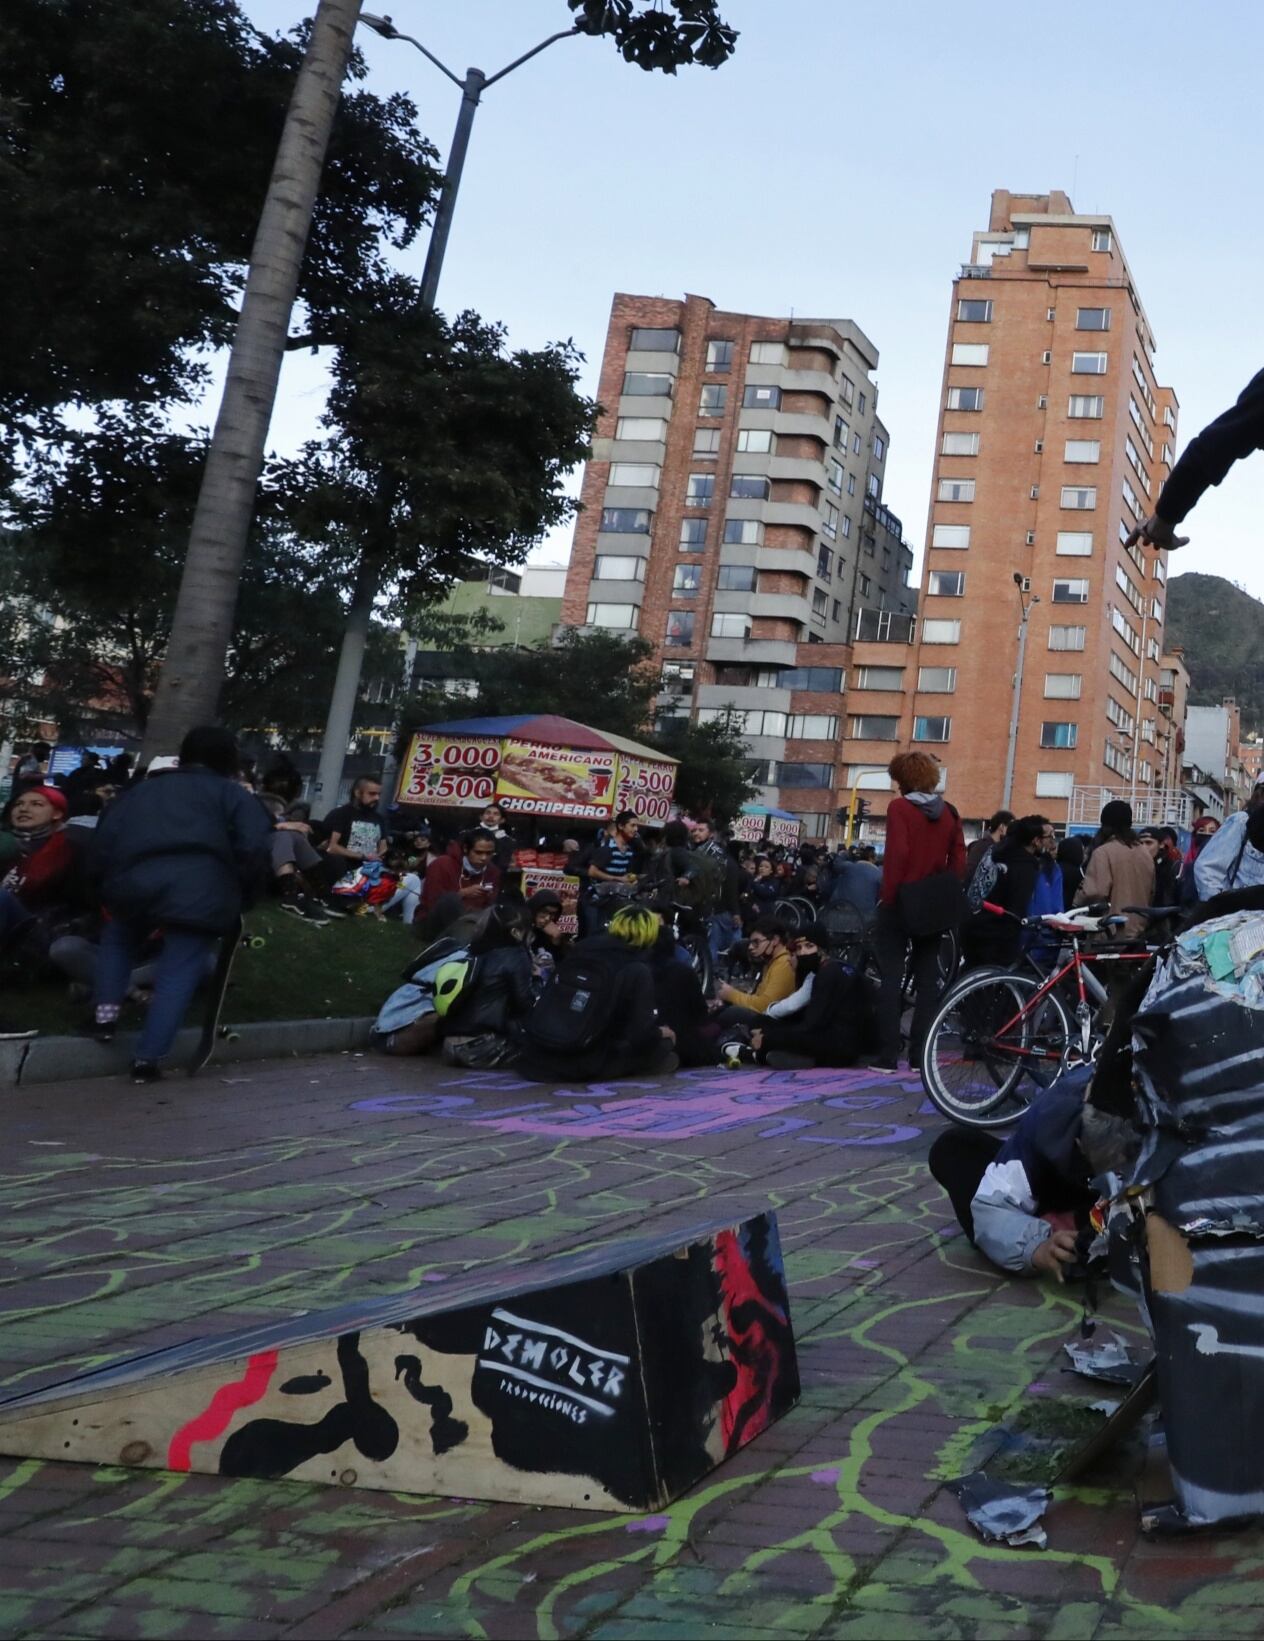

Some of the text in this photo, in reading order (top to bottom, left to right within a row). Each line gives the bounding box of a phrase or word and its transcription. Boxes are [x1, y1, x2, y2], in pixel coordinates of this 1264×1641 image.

[413, 743, 499, 768] 3.000
[528, 750, 613, 766] AMERICANO
[407, 774, 493, 799] 3.500
[619, 765, 673, 793] 2.500
[498, 797, 608, 817] CHORIPERRO
[525, 873, 565, 882] PERRO
[483, 1326, 625, 1396] DEMOLER
